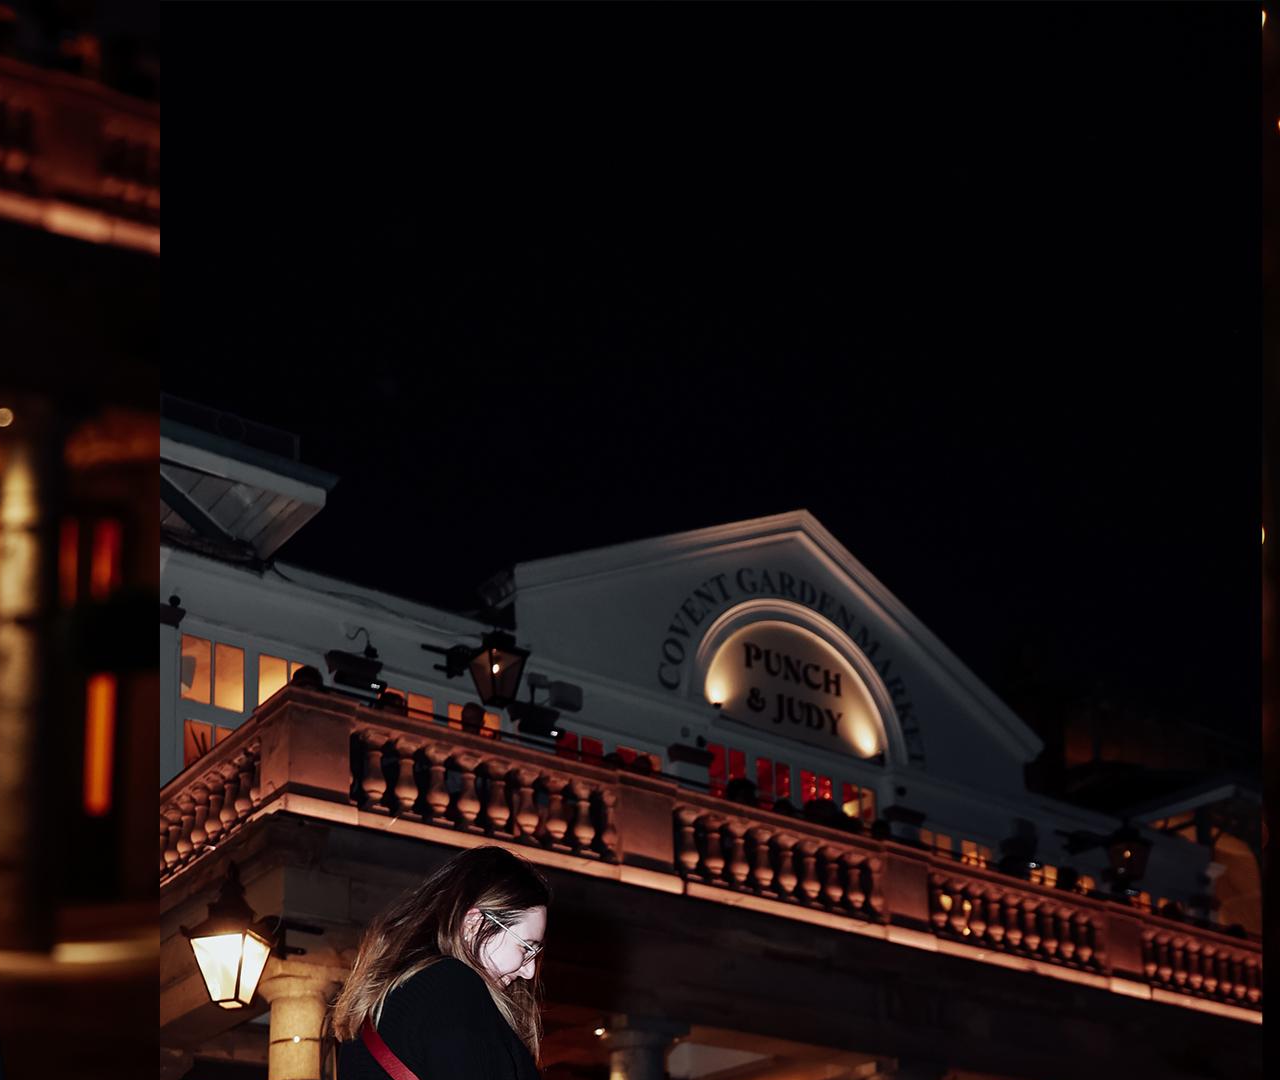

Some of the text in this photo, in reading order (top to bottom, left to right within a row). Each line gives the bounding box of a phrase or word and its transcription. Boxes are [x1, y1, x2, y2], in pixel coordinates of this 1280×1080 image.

[658, 568, 925, 769] COVENT GARDEN MARKET
[744, 644, 842, 696] PUNCH
[747, 688, 842, 736] & JUDY
